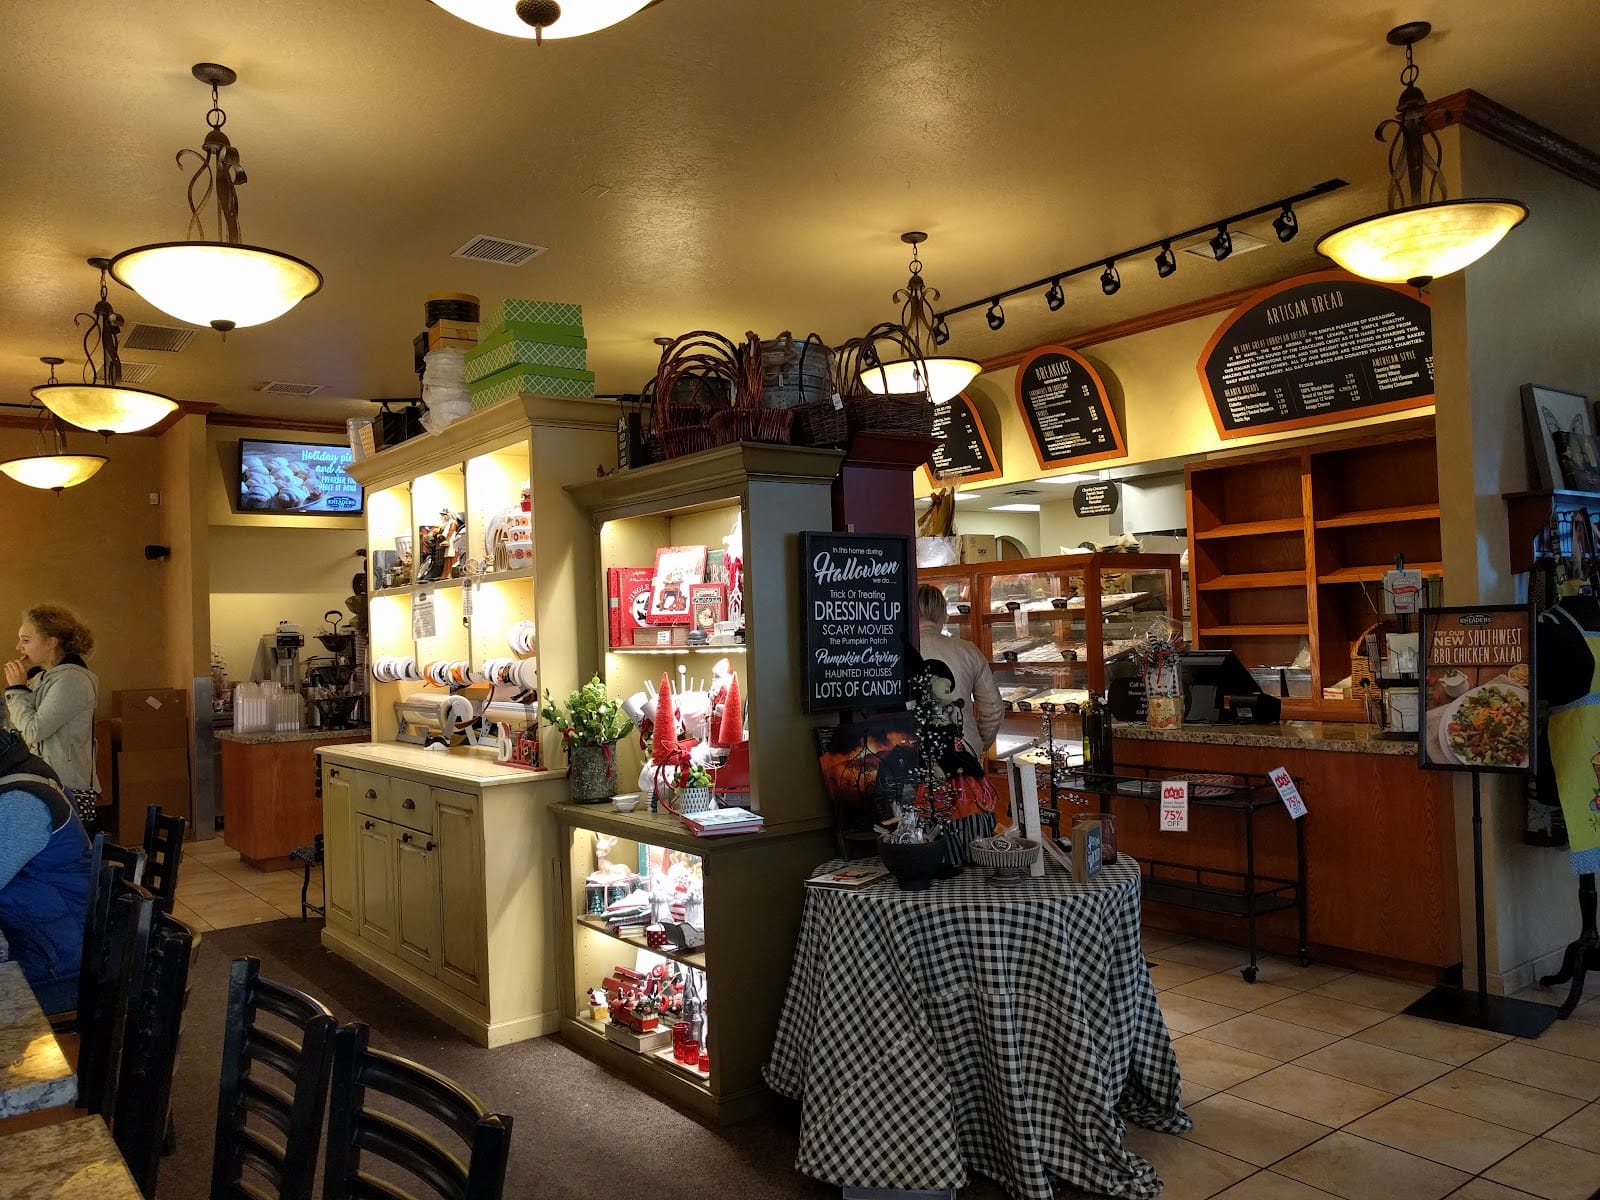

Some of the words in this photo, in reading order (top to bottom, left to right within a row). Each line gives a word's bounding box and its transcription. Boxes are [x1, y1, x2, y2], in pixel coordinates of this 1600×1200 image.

[1267, 299, 1309, 324] ARTISAN
[1311, 291, 1344, 313] BREAD
[1285, 340, 1303, 348] AROMA
[1361, 322, 1379, 330] SIMPLE
[1381, 316, 1405, 326] HEALTHY
[1318, 326, 1335, 334] SIMPLE
[1335, 320, 1360, 330] PLEASURE
[1368, 312, 1396, 322] KNEADING
[1265, 351, 1281, 359] SOUND
[1298, 341, 1325, 351] CRACKLING
[1325, 337, 1341, 345] CRUST
[1360, 329, 1376, 337] HAND
[1376, 325, 1396, 333] PEELED
[1395, 321, 1412, 329] FROM
[1319, 344, 1340, 352] DELIGHT
[1356, 336, 1375, 344] FOUND
[1382, 329, 1406, 338] SHARING
[1351, 338, 1392, 351] SCRATCH-MIXED
[1406, 331, 1426, 339] BAKED
[1344, 350, 1369, 359] DONATED
[1377, 344, 1395, 352] LOCAL
[1372, 354, 1399, 367] AMERICAN
[1400, 350, 1416, 361] STYLE
[1035, 360, 1072, 380] BREAKFAST
[302, 450, 339, 464] Holiday
[316, 463, 334, 473] and
[848, 547, 865, 555] home
[865, 548, 883, 556] during
[813, 551, 900, 585] Halloween
[628, 584, 650, 603] JINGLE
[830, 589, 846, 599] Trick
[847, 589, 857, 599] Or
[858, 589, 886, 601] Treating
[814, 601, 880, 621] DRESSING
[883, 601, 901, 621] UP
[822, 624, 855, 636] SCARY
[857, 624, 894, 635] MOVIES
[1434, 636, 1464, 646] NEW
[1468, 628, 1522, 646] SOUTHWEST
[829, 637, 841, 645] The
[842, 637, 868, 646] Pumpkin
[869, 637, 888, 645] Patch
[815, 648, 861, 666] Pumpkin
[861, 646, 901, 668] Carving
[1434, 648, 1451, 665] BBQ
[1453, 647, 1489, 663] CHICKEN
[1493, 646, 1522, 662] SALAD
[825, 668, 861, 679] HAUNTED
[863, 667, 893, 678] HOUSES
[815, 682, 842, 699] LOTS
[844, 681, 860, 697] OF
[862, 680, 902, 697] CANDY!
[1164, 788, 1184, 799] SALE
[1286, 794, 1300, 808] 75%
[1164, 810, 1184, 821] 75%
[1167, 820, 1181, 828] OFF
